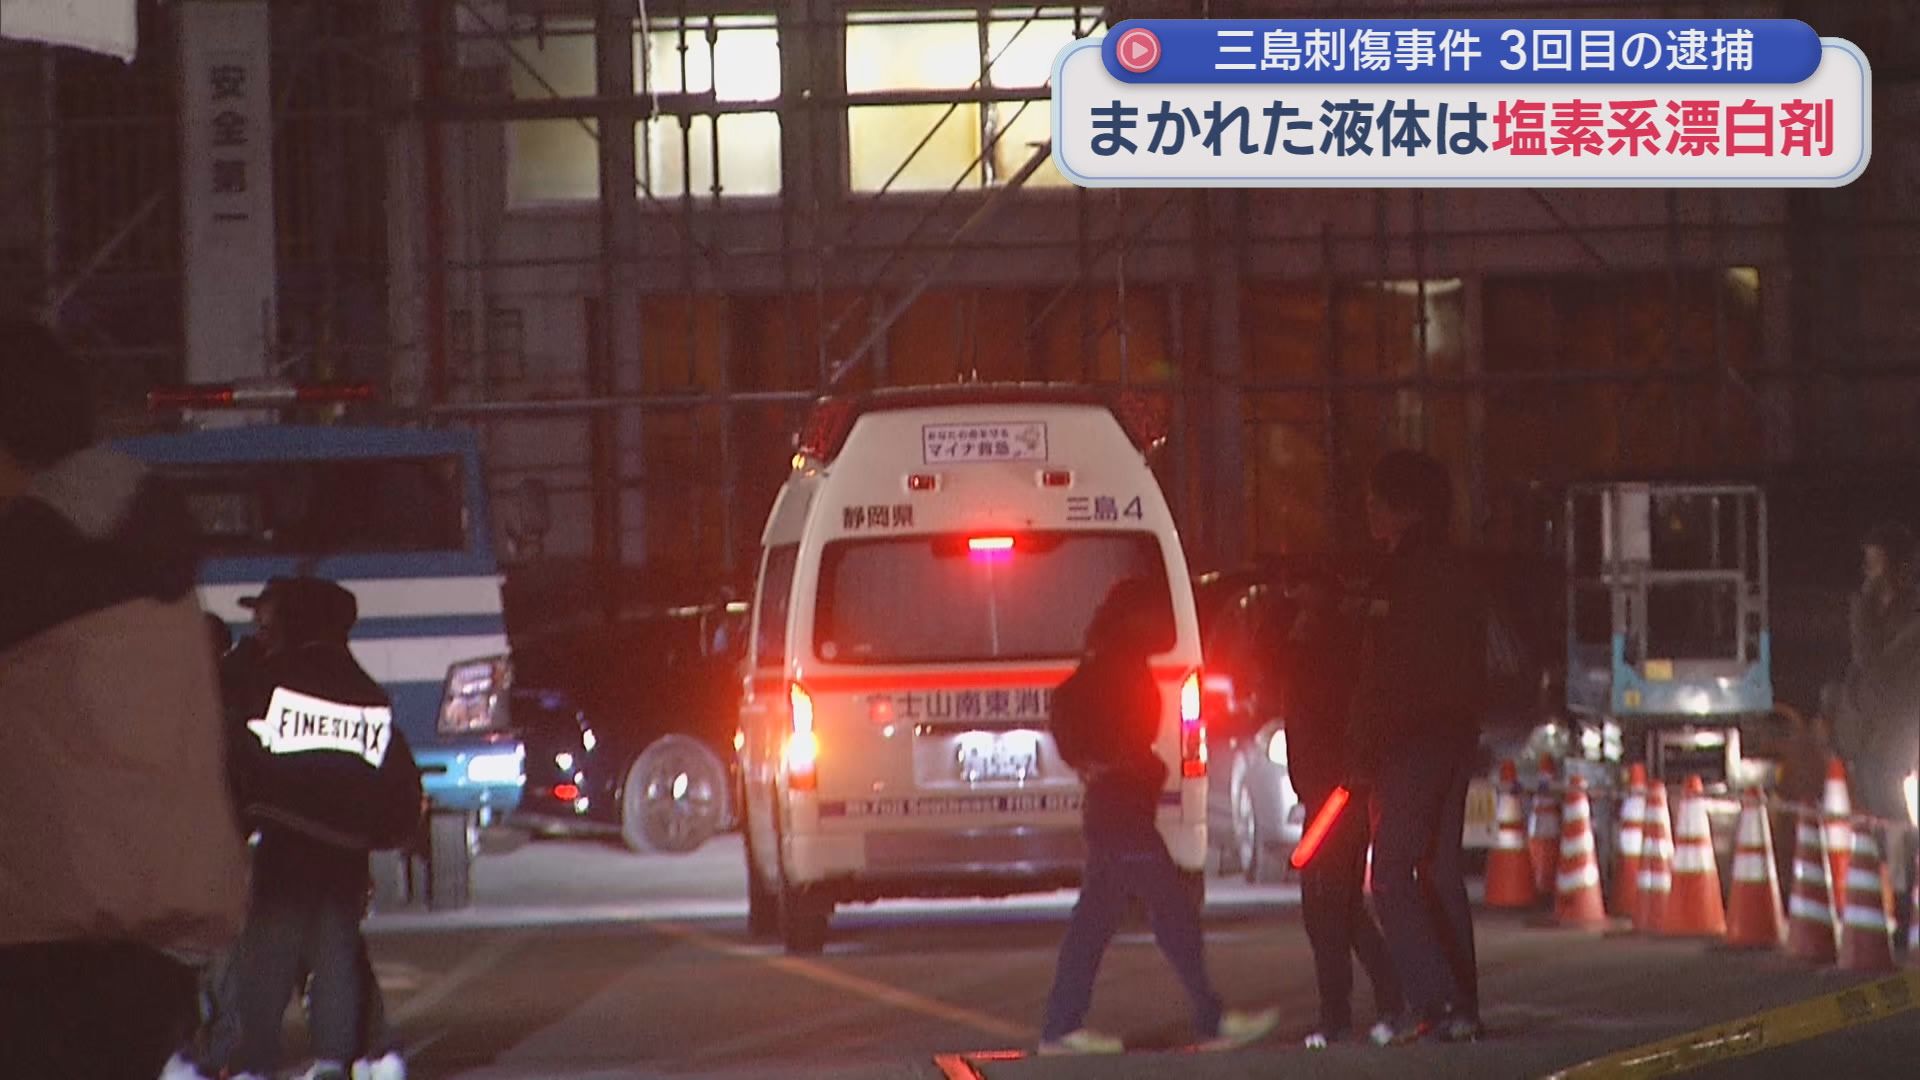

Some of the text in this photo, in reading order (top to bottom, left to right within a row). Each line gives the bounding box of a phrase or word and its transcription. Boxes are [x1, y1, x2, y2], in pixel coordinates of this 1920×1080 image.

[842, 504, 914, 529] 静岡県
[1066, 499, 1144, 522] 三島4
